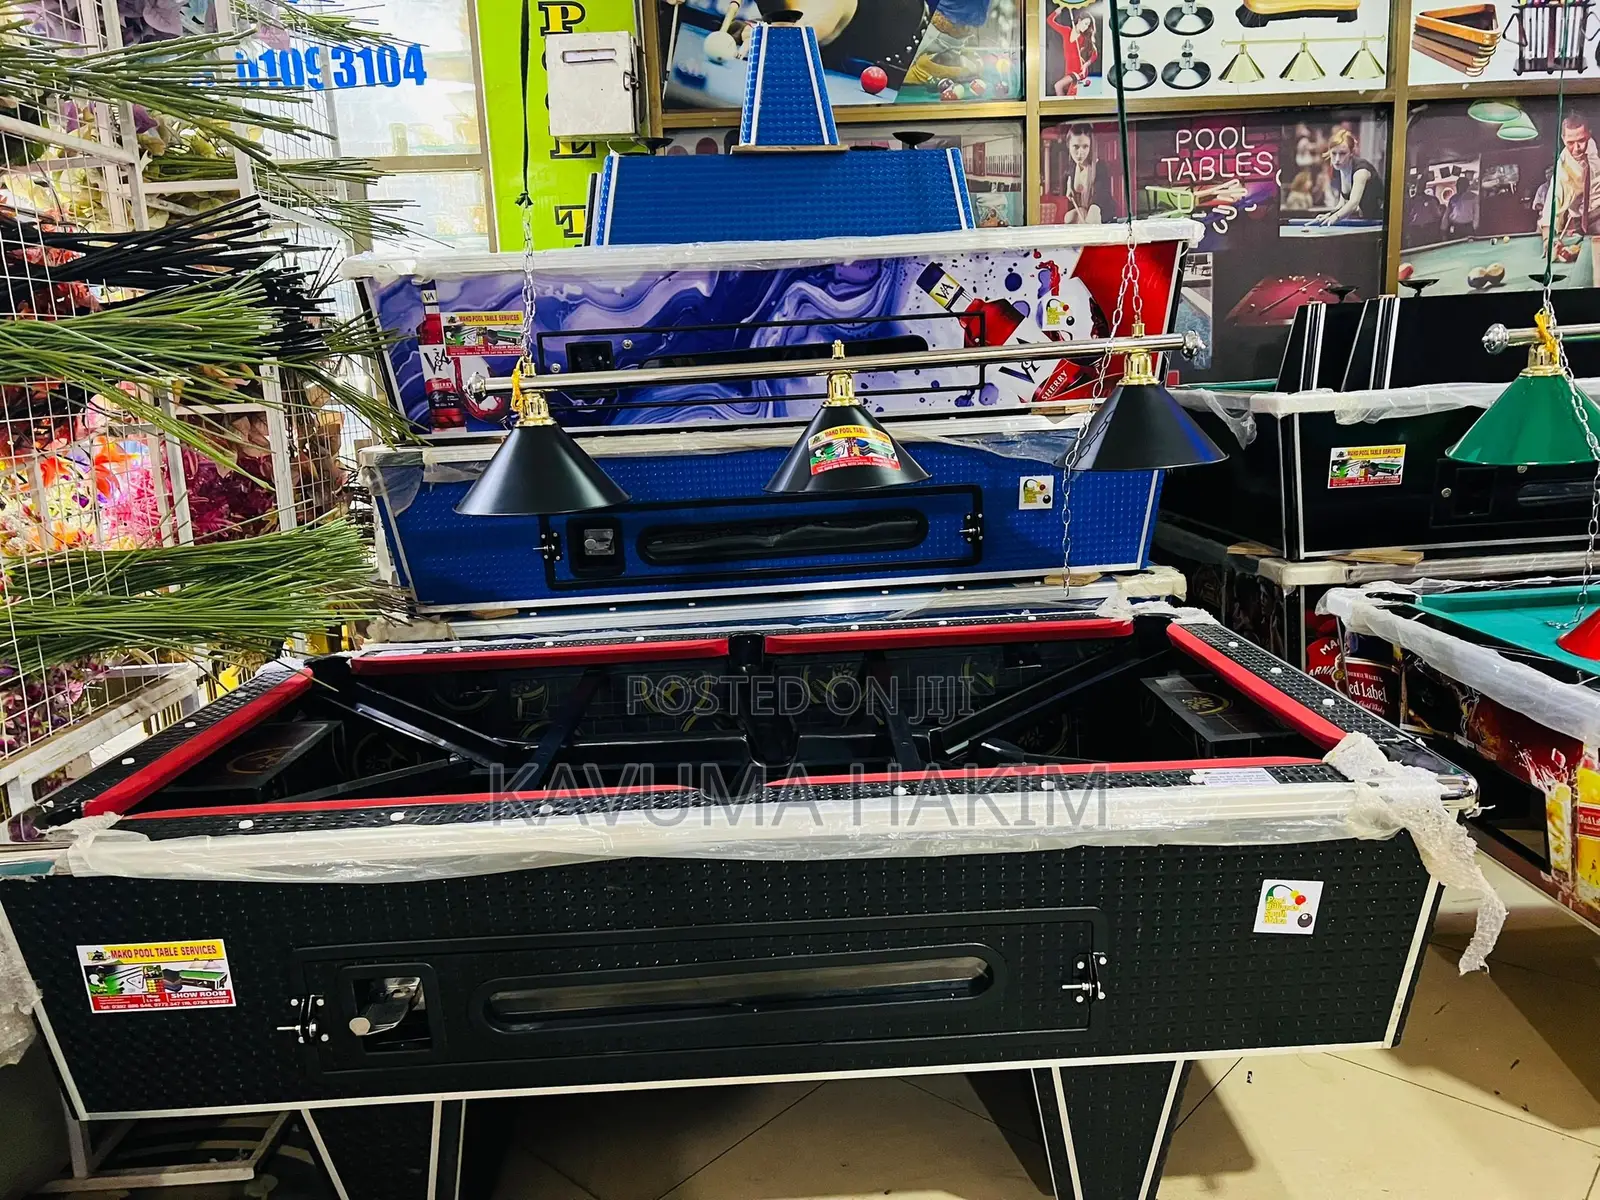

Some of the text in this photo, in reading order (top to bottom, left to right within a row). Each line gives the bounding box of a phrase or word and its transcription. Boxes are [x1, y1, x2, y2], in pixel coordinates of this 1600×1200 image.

[1175, 126, 1255, 154] POOL
[1160, 151, 1274, 182] TABLES
[1041, 369, 1068, 400] SHERRY
[1349, 681, 1388, 703] ed Label
[110, 949, 133, 959] MAKO
[133, 948, 155, 958] POOL
[155, 947, 179, 957] TABLE
[180, 945, 217, 956] SERVICES
[199, 990, 227, 998] ROOM
